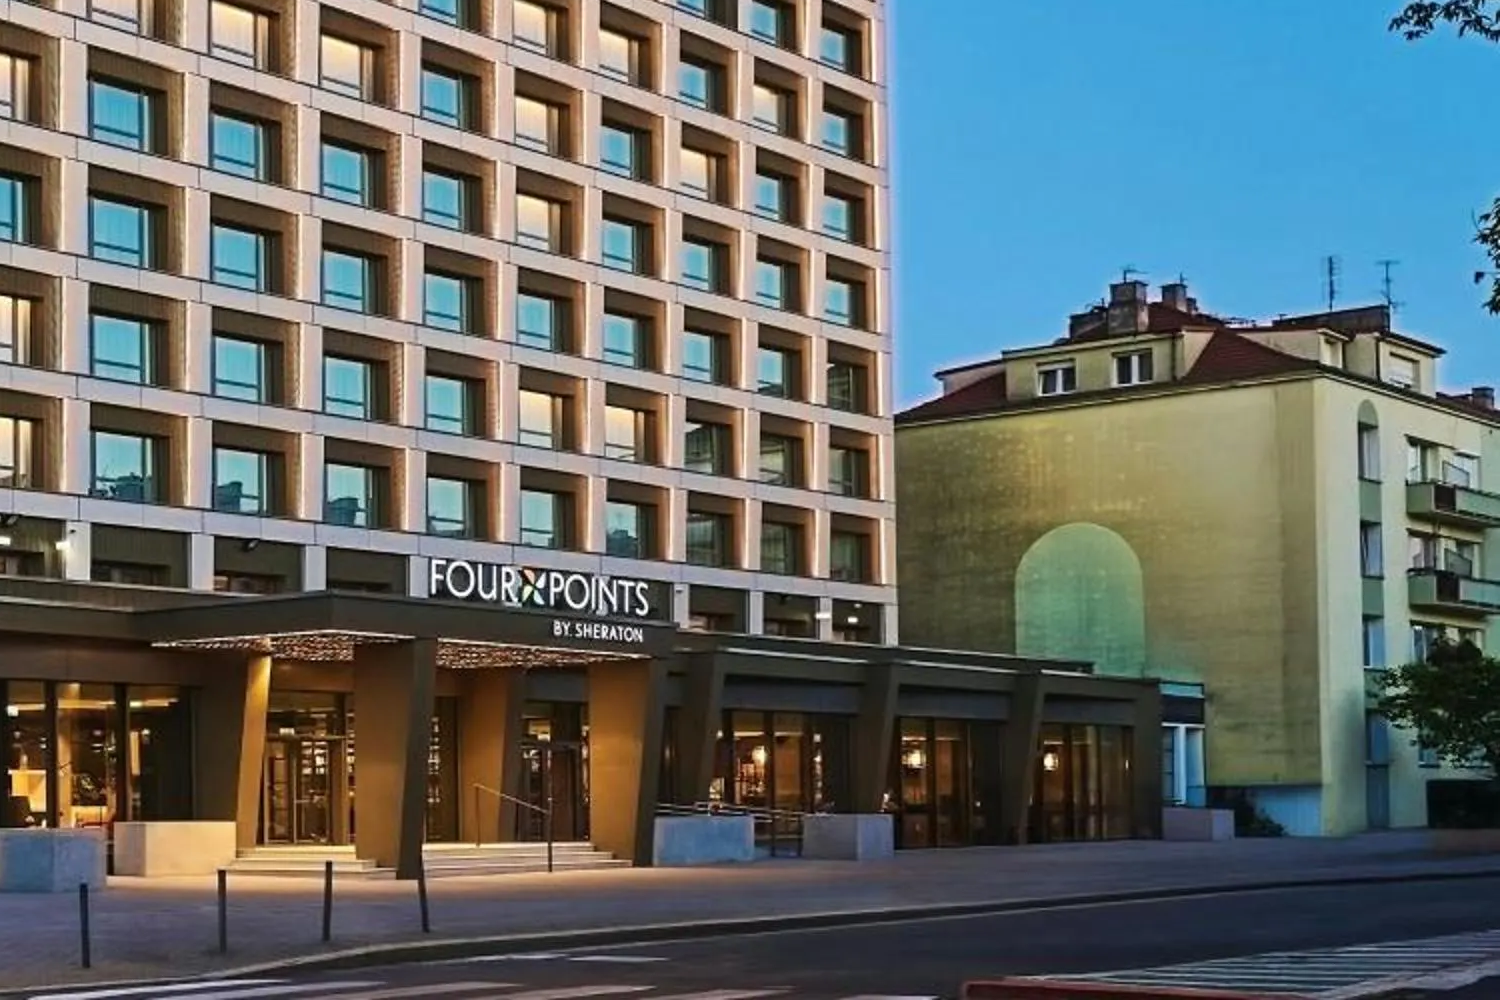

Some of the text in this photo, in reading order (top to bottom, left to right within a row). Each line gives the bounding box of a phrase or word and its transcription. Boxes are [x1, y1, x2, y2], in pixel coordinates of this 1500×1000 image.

[431, 559, 649, 617] FOUR POINTS
[575, 623, 644, 643] SHERATON
